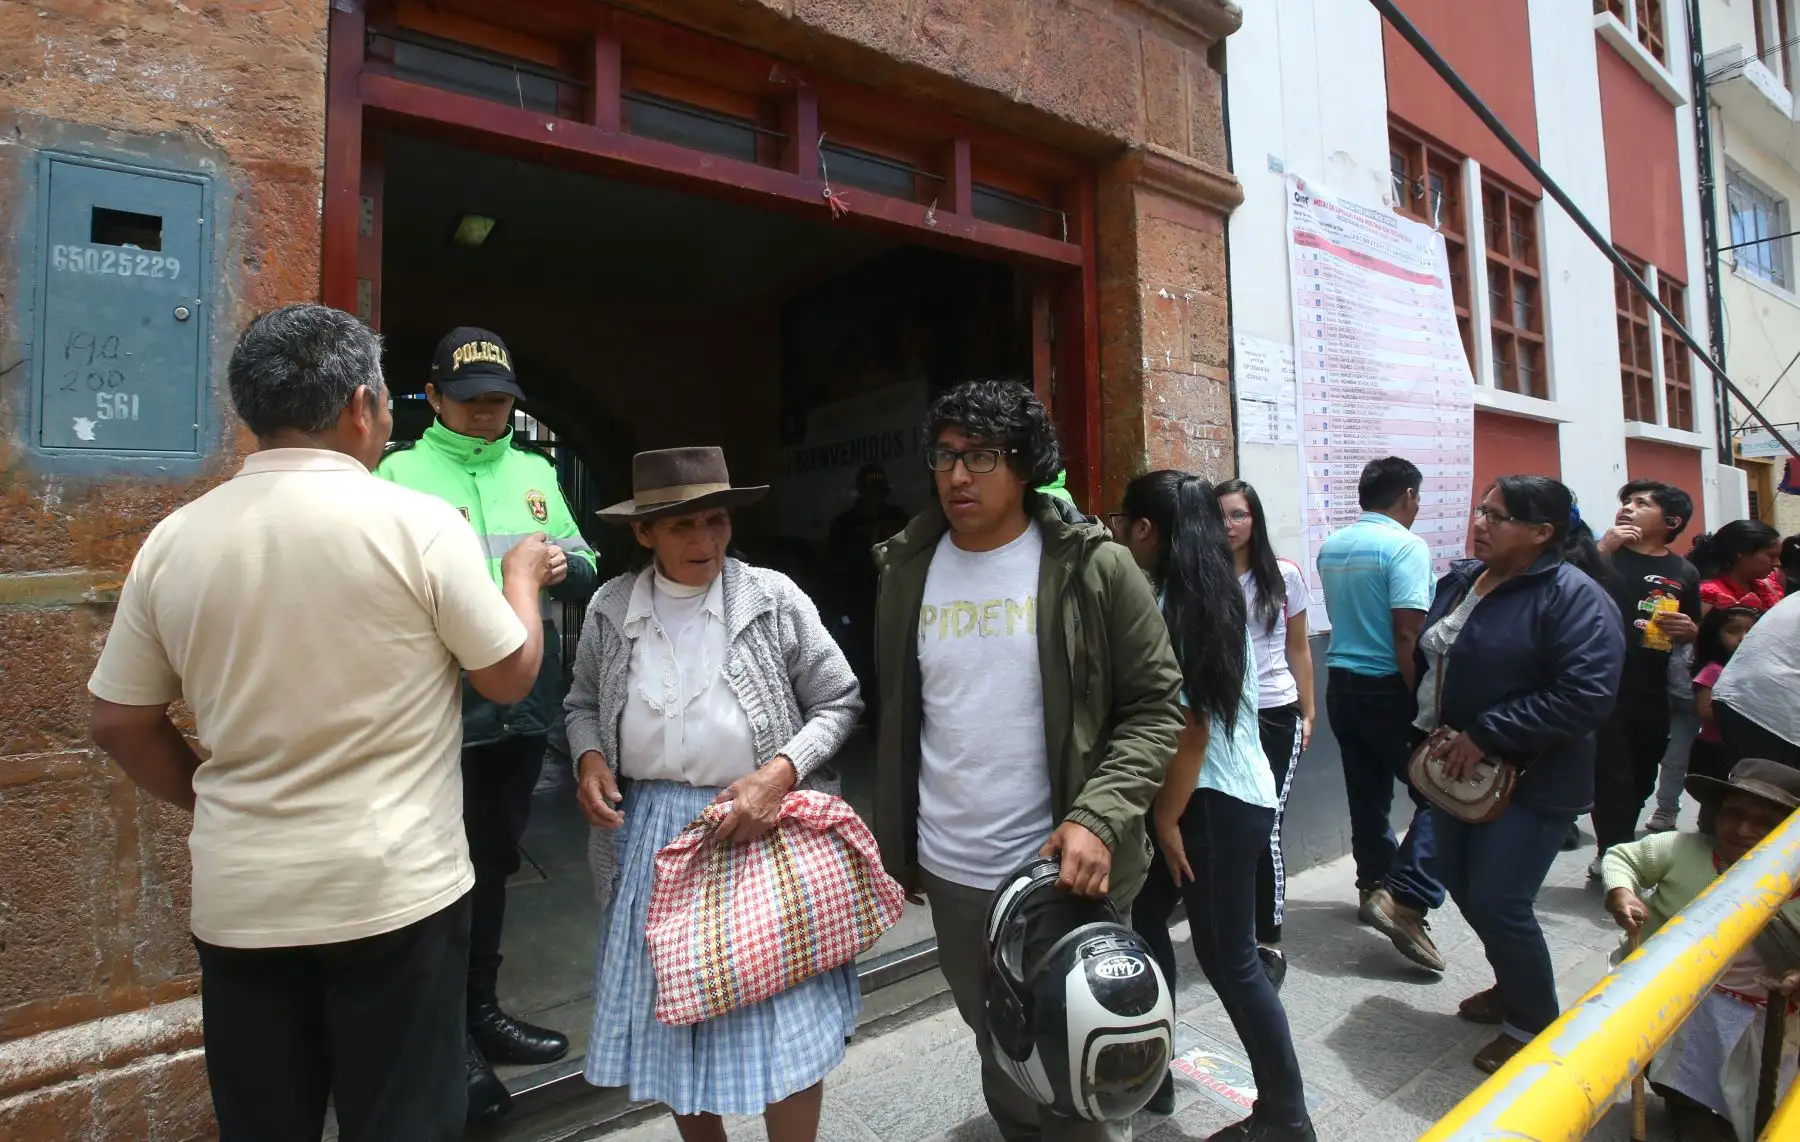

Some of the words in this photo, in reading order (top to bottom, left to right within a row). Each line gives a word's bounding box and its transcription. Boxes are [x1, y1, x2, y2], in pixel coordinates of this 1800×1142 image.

[53, 245, 180, 280] 65025229
[453, 341, 510, 371] POLICIA
[97, 392, 139, 420] 561
